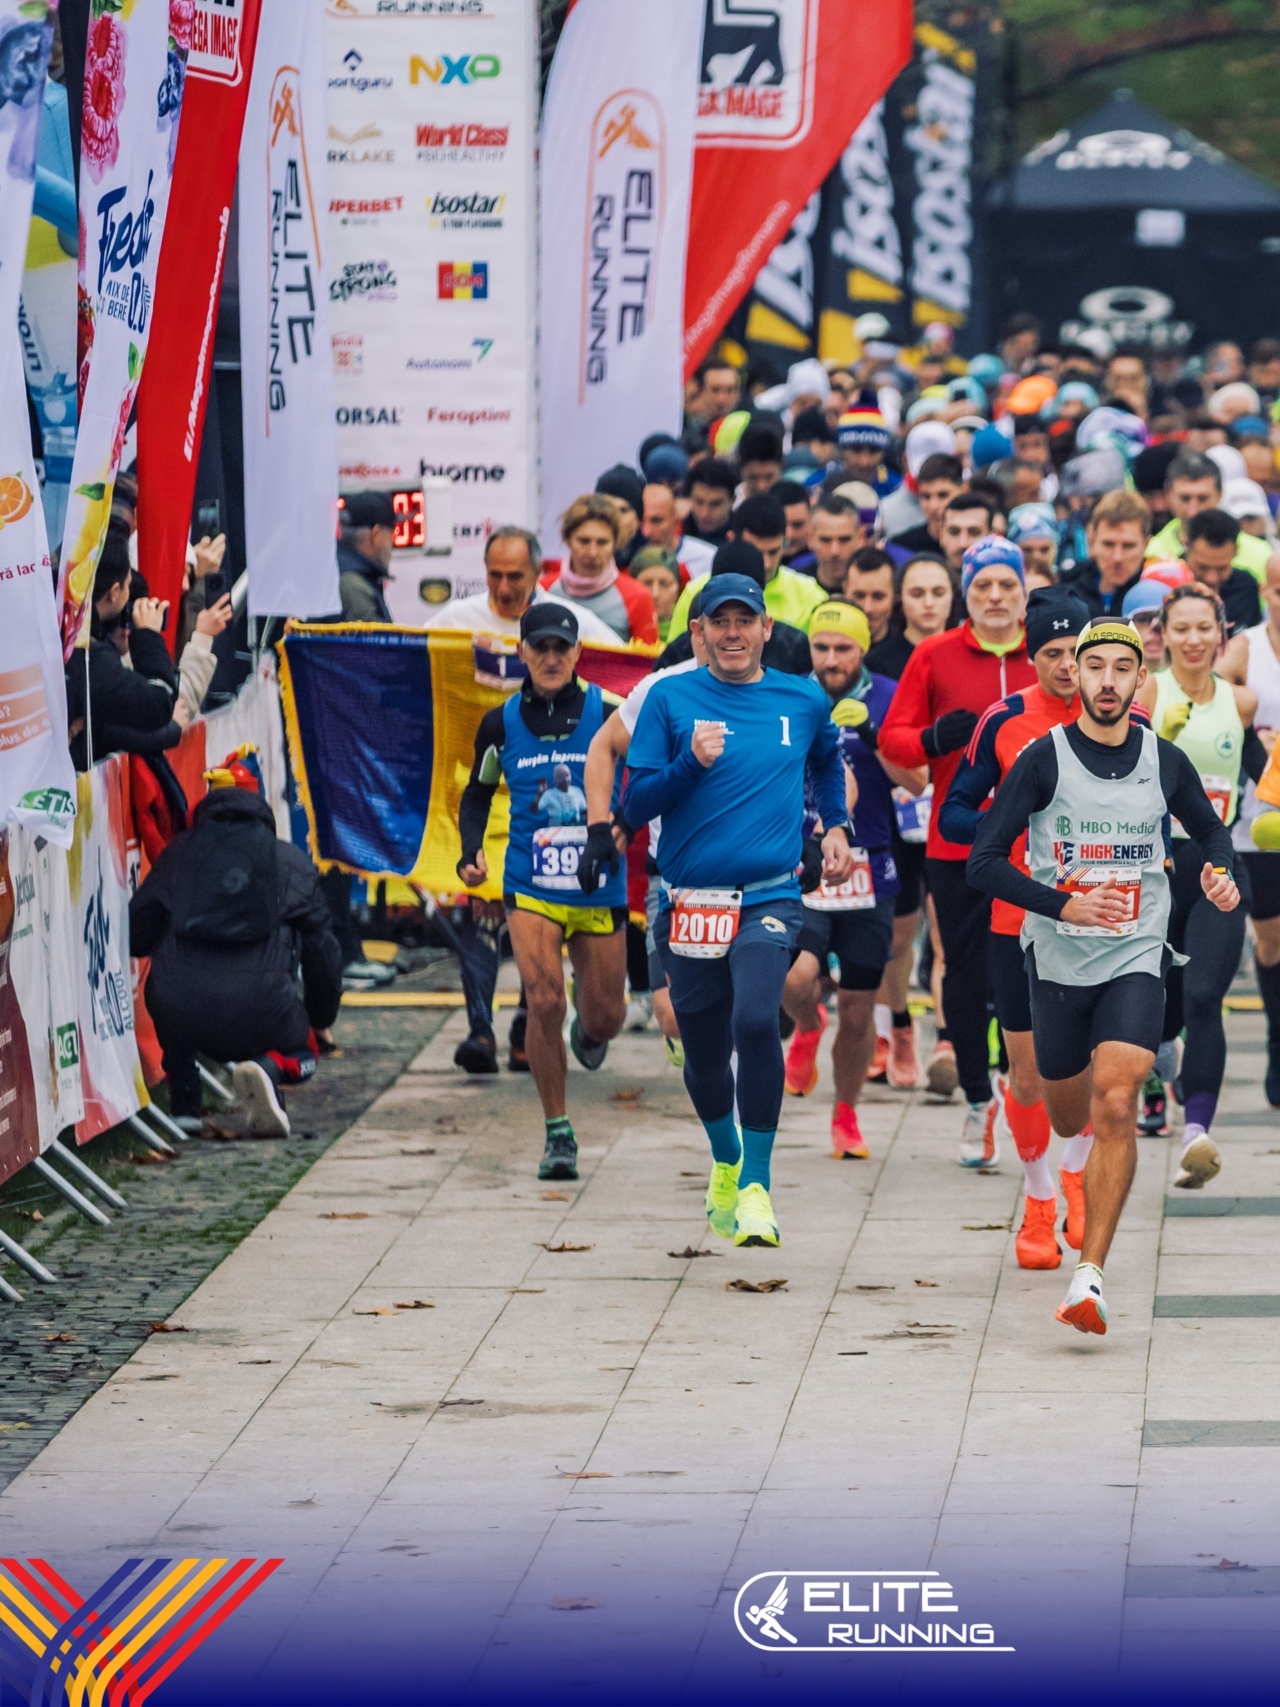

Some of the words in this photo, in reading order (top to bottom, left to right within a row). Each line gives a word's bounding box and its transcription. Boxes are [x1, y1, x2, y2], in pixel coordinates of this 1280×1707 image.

[409, 55, 500, 85] NXP
[416, 125, 463, 146] World
[465, 123, 510, 146] Class
[432, 191, 500, 214] isostar
[618, 168, 653, 345] ELITE
[587, 194, 615, 385] RUNNING
[108, 300, 127, 321] BERE
[780, 716, 792, 746] 1
[1080, 821, 1112, 834] HBO
[542, 846, 585, 876] 39
[678, 912, 734, 943] 2010
